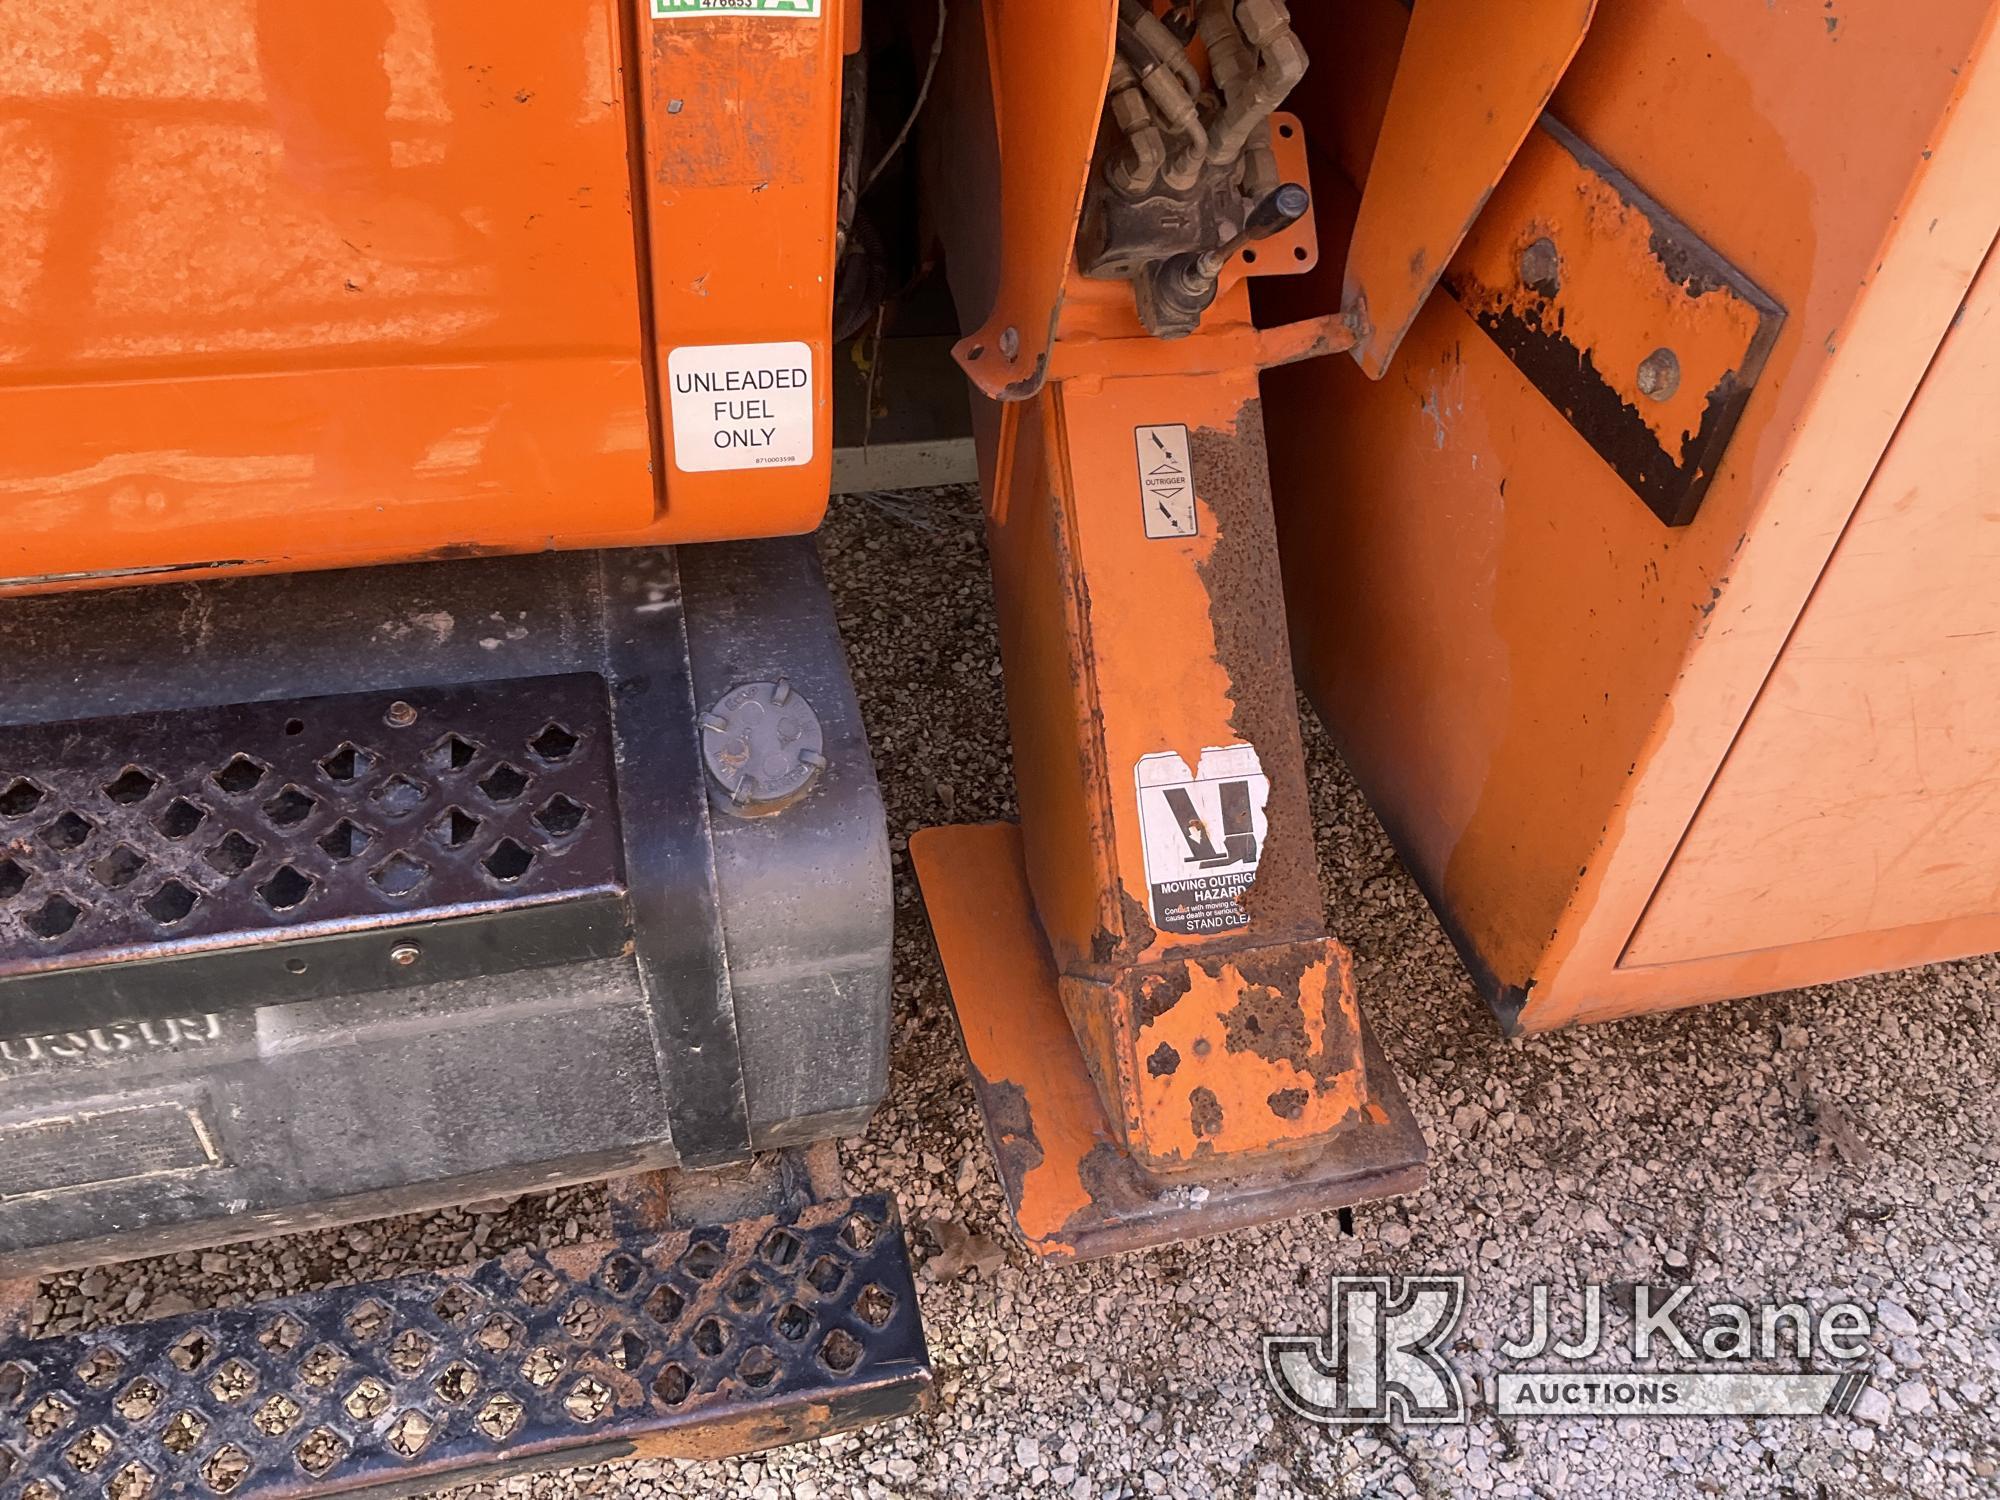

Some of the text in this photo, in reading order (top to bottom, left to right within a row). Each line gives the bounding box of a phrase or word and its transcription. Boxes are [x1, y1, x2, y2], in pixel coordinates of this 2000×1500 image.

[676, 368, 807, 393] UNLEADED
[714, 400, 775, 421] FUEL
[714, 428, 776, 448] ONLY
[1145, 476, 1186, 486] OUTRIGGER
[1161, 879, 1207, 894] MOVING
[1194, 885, 1247, 902] HAZARD
[1205, 901, 1229, 910] moving
[1165, 914, 1185, 922] cause
[1186, 911, 1205, 919] death
[1213, 907, 1238, 916] serious
[1186, 916, 1223, 930] STAND
